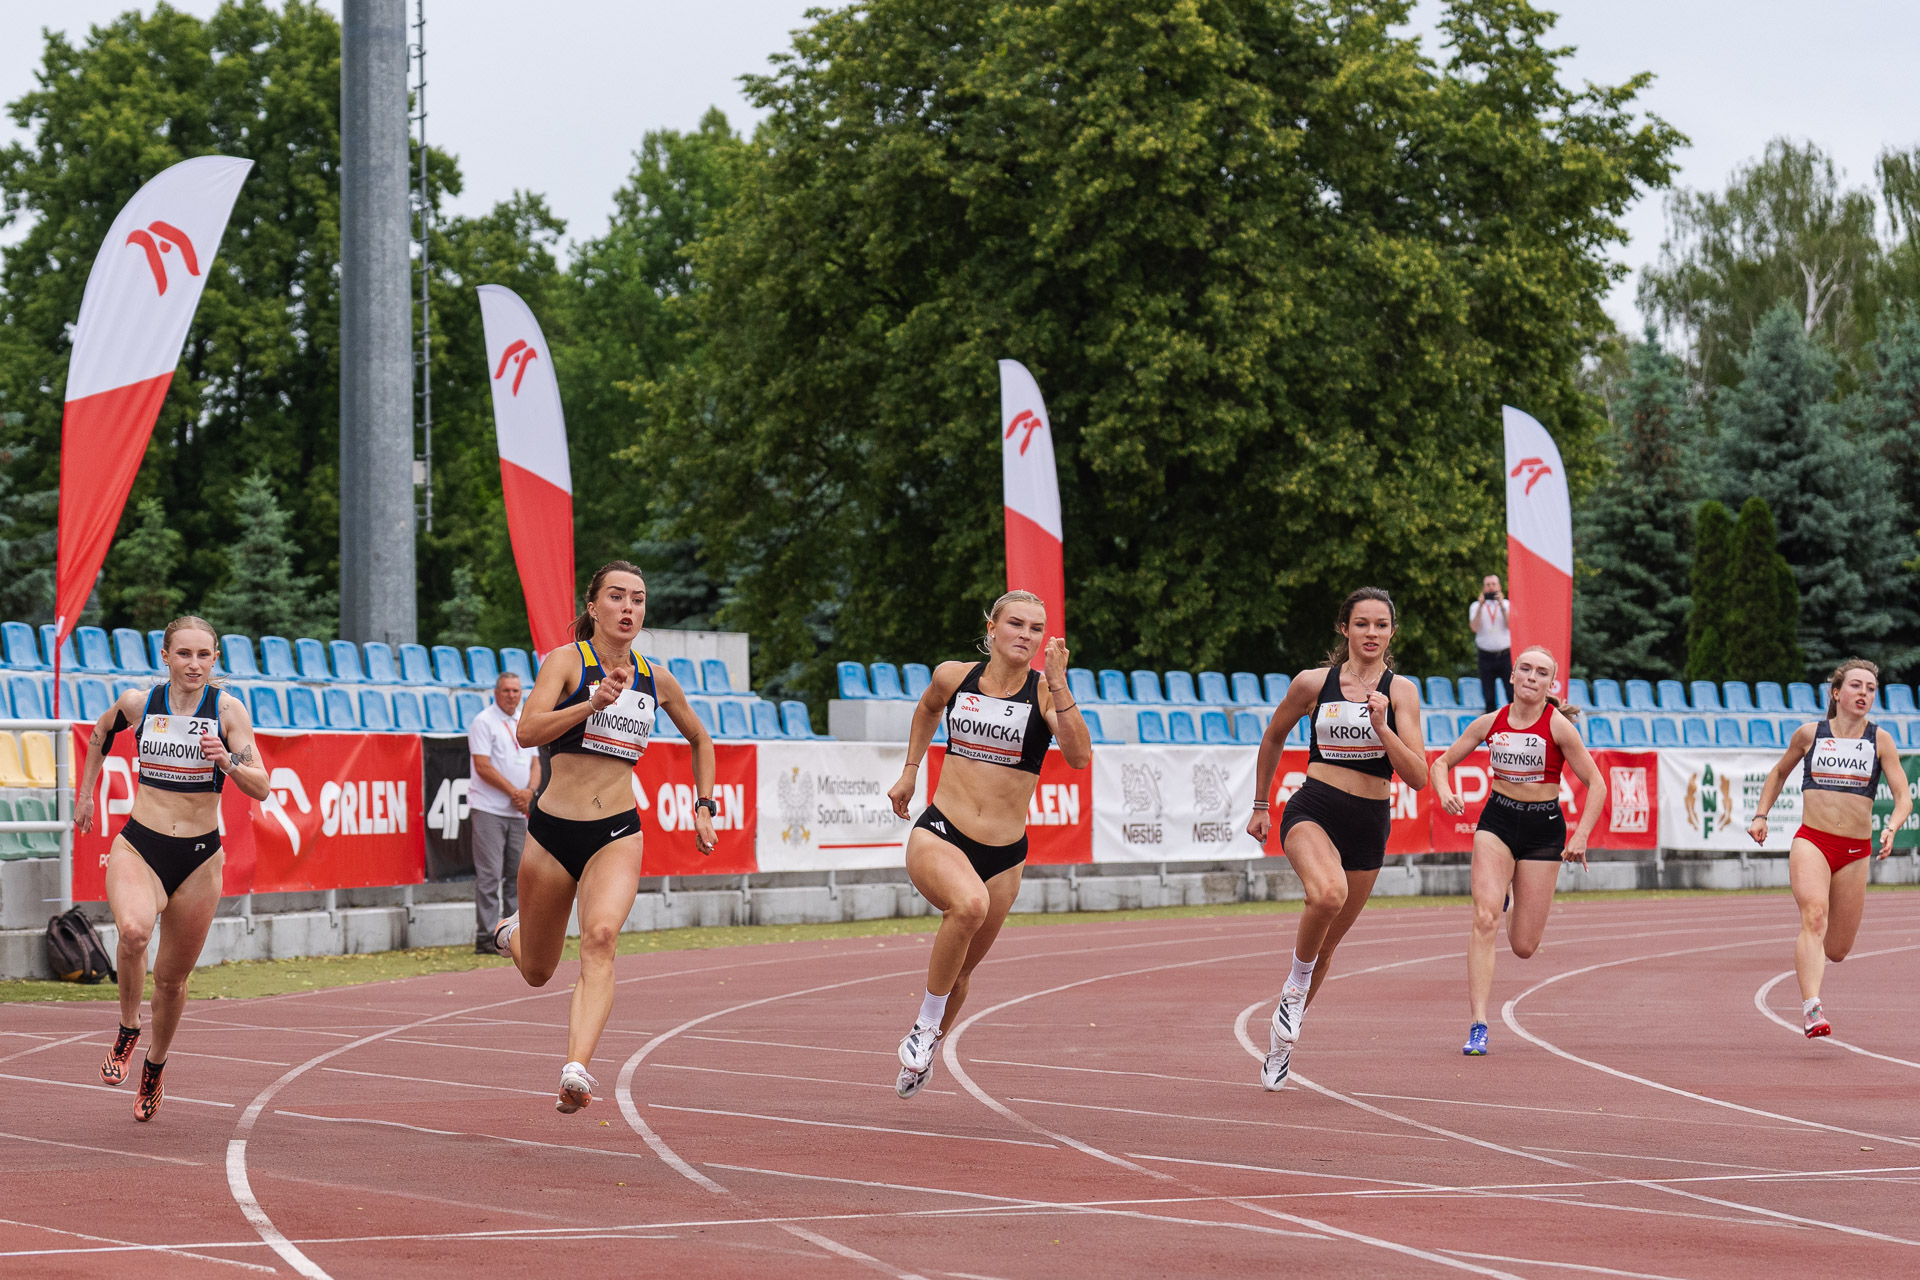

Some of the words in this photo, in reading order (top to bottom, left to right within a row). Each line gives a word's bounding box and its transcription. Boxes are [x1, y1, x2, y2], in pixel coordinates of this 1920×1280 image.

[637, 697, 646, 710] 6
[961, 705, 980, 713] ORLEN
[1003, 705, 1014, 717] 5
[187, 720, 209, 735] 25
[591, 711, 650, 738] WINOGRODZKA
[951, 717, 1021, 744] NOWICKA
[1329, 725, 1372, 740] KROK
[592, 742, 630, 757] WARSZAWA
[1524, 737, 1538, 748] 12
[1855, 742, 1863, 752] 4
[957, 746, 993, 761] WARSZAWA
[994, 755, 1011, 763] 2025
[1324, 751, 1362, 759] WARSZAWA
[1363, 751, 1379, 759] 2025
[1491, 750, 1544, 766] MYSZYŃSKA
[1816, 756, 1868, 771] NOWAK
[148, 770, 187, 780] WARSZAWA
[188, 773, 205, 781] 2025
[818, 775, 880, 795] Ministerstwo
[319, 780, 408, 838] ORLEN
[427, 777, 471, 840] 4F
[1495, 795, 1526, 811] NIKE
[1527, 802, 1556, 812] PRO
[817, 803, 853, 827] Sportu
